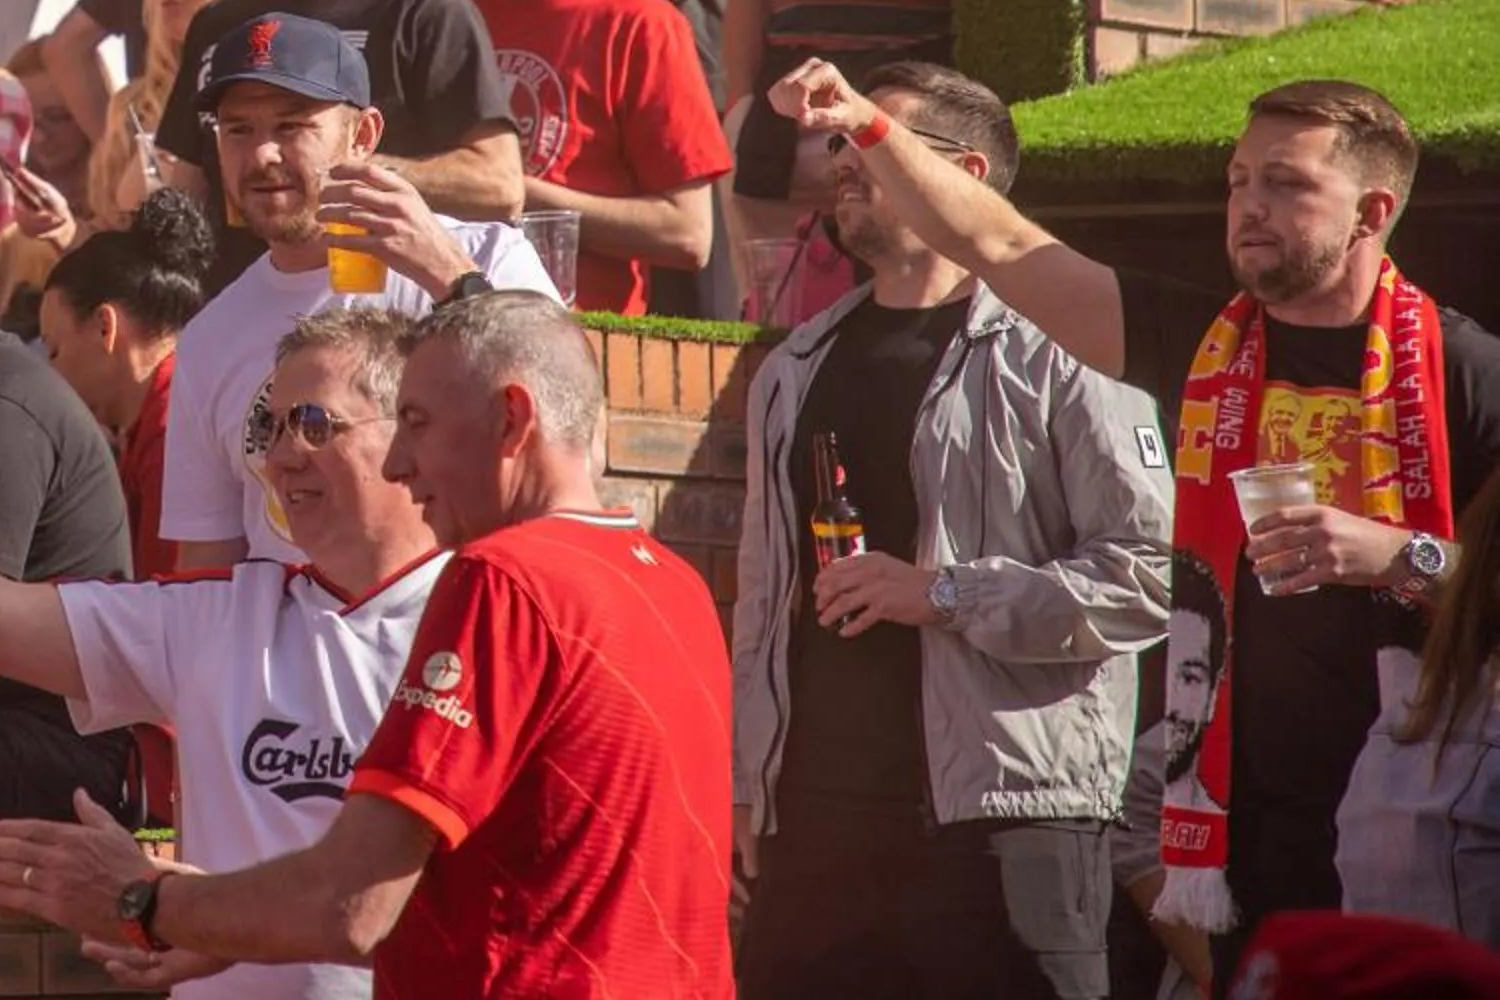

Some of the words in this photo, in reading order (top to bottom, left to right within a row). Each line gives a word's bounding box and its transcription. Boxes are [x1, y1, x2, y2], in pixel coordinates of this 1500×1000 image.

[1395, 307, 1422, 335] LA
[1396, 340, 1424, 369] LA
[1397, 374, 1425, 406] LA
[1214, 386, 1250, 450] WING
[1401, 414, 1432, 499] SALAH
[242, 718, 356, 786] Carlsb
